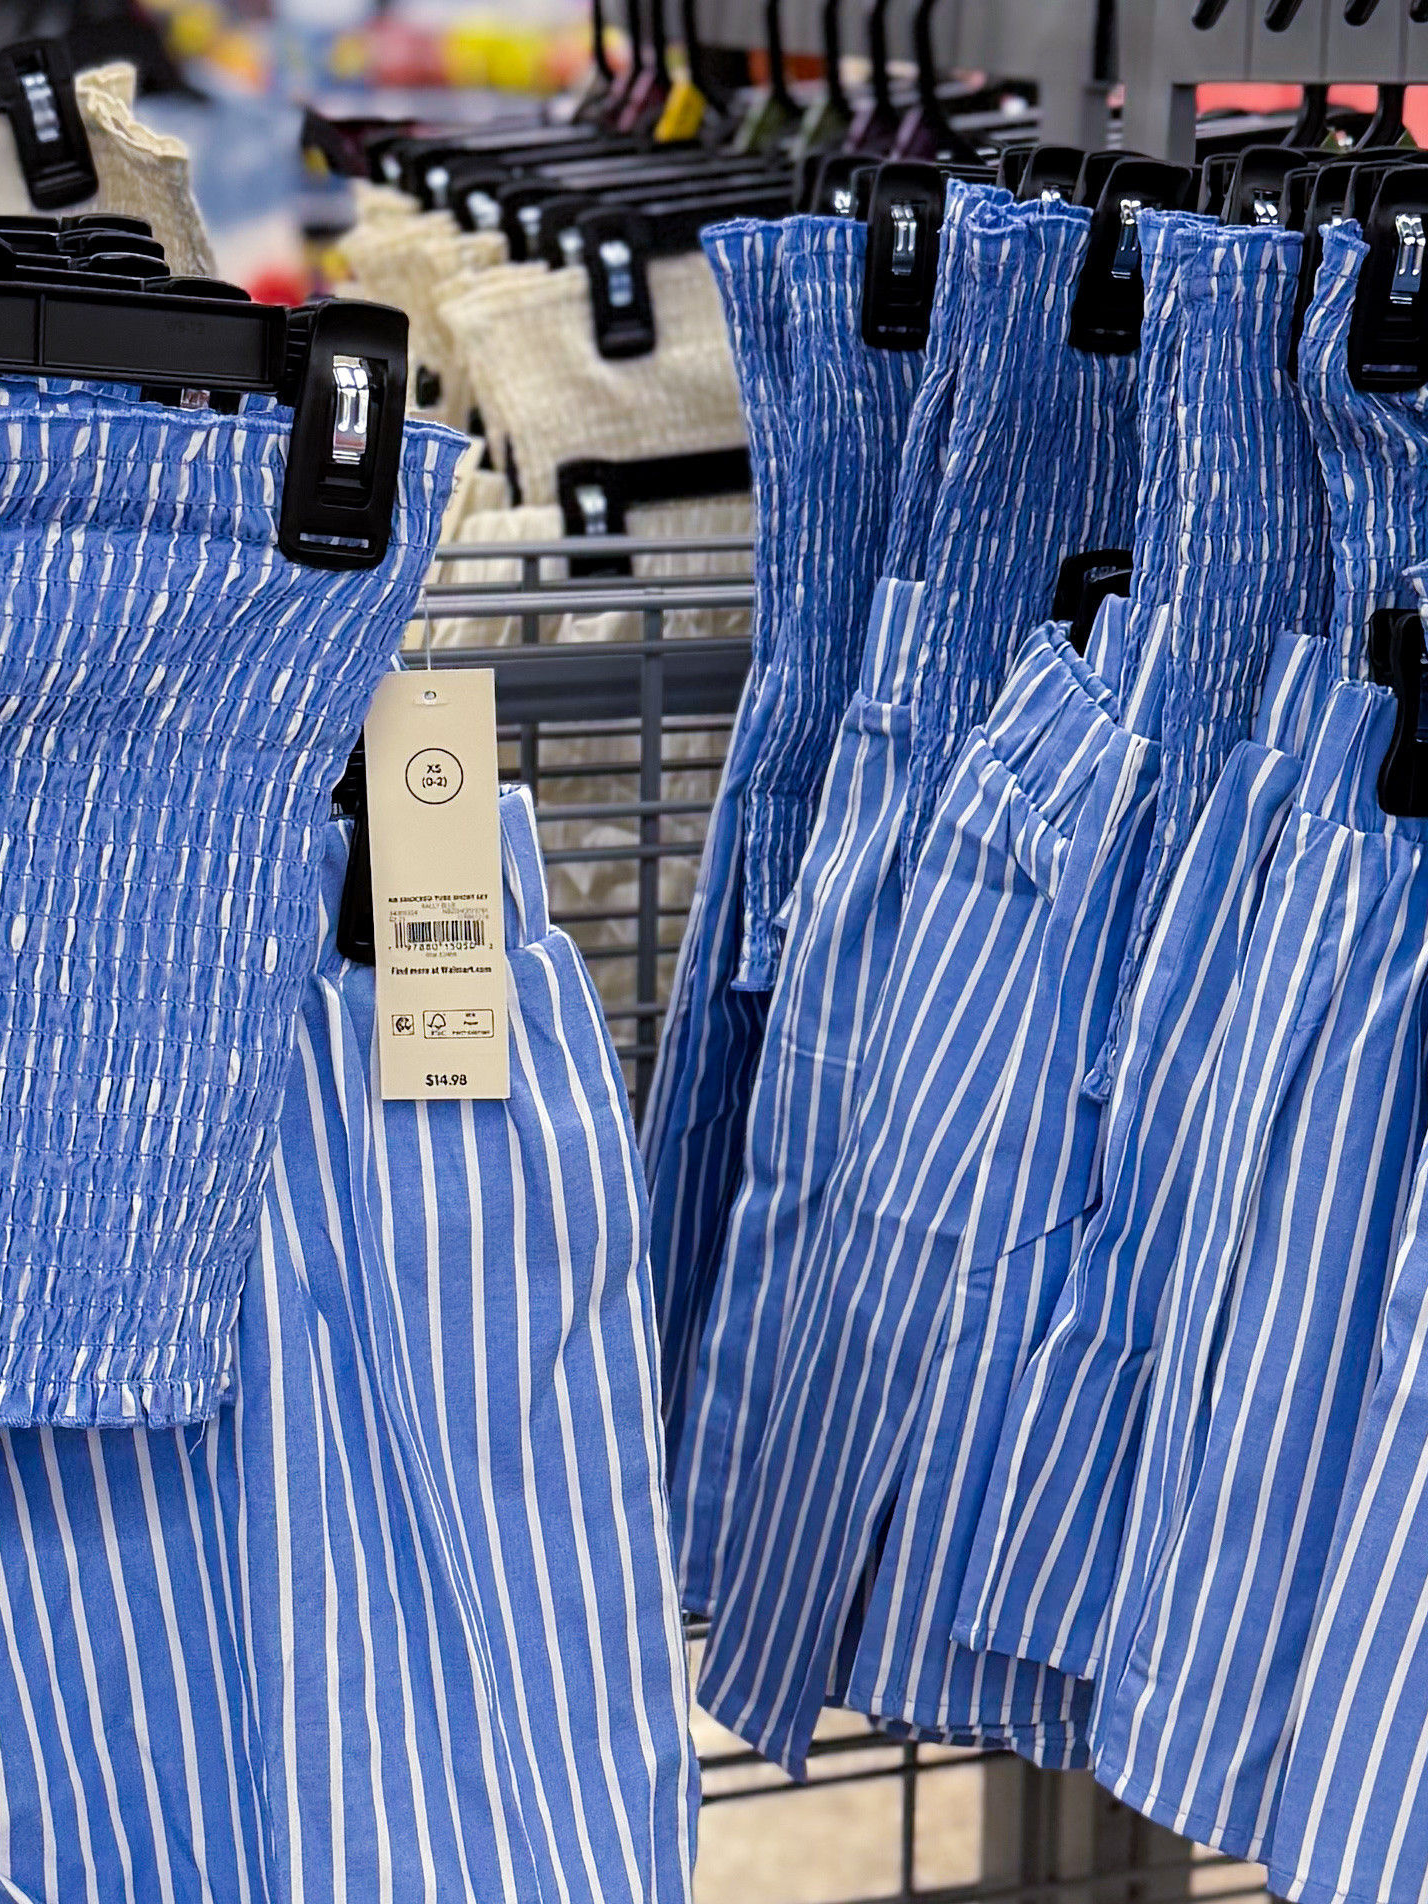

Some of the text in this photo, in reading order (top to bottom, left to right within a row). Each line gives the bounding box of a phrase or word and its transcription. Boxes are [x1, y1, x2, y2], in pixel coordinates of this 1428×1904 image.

[426, 763, 442, 774] XS
[421, 776, 448, 789] (0-2)
[425, 1073, 468, 1087] $14.98
